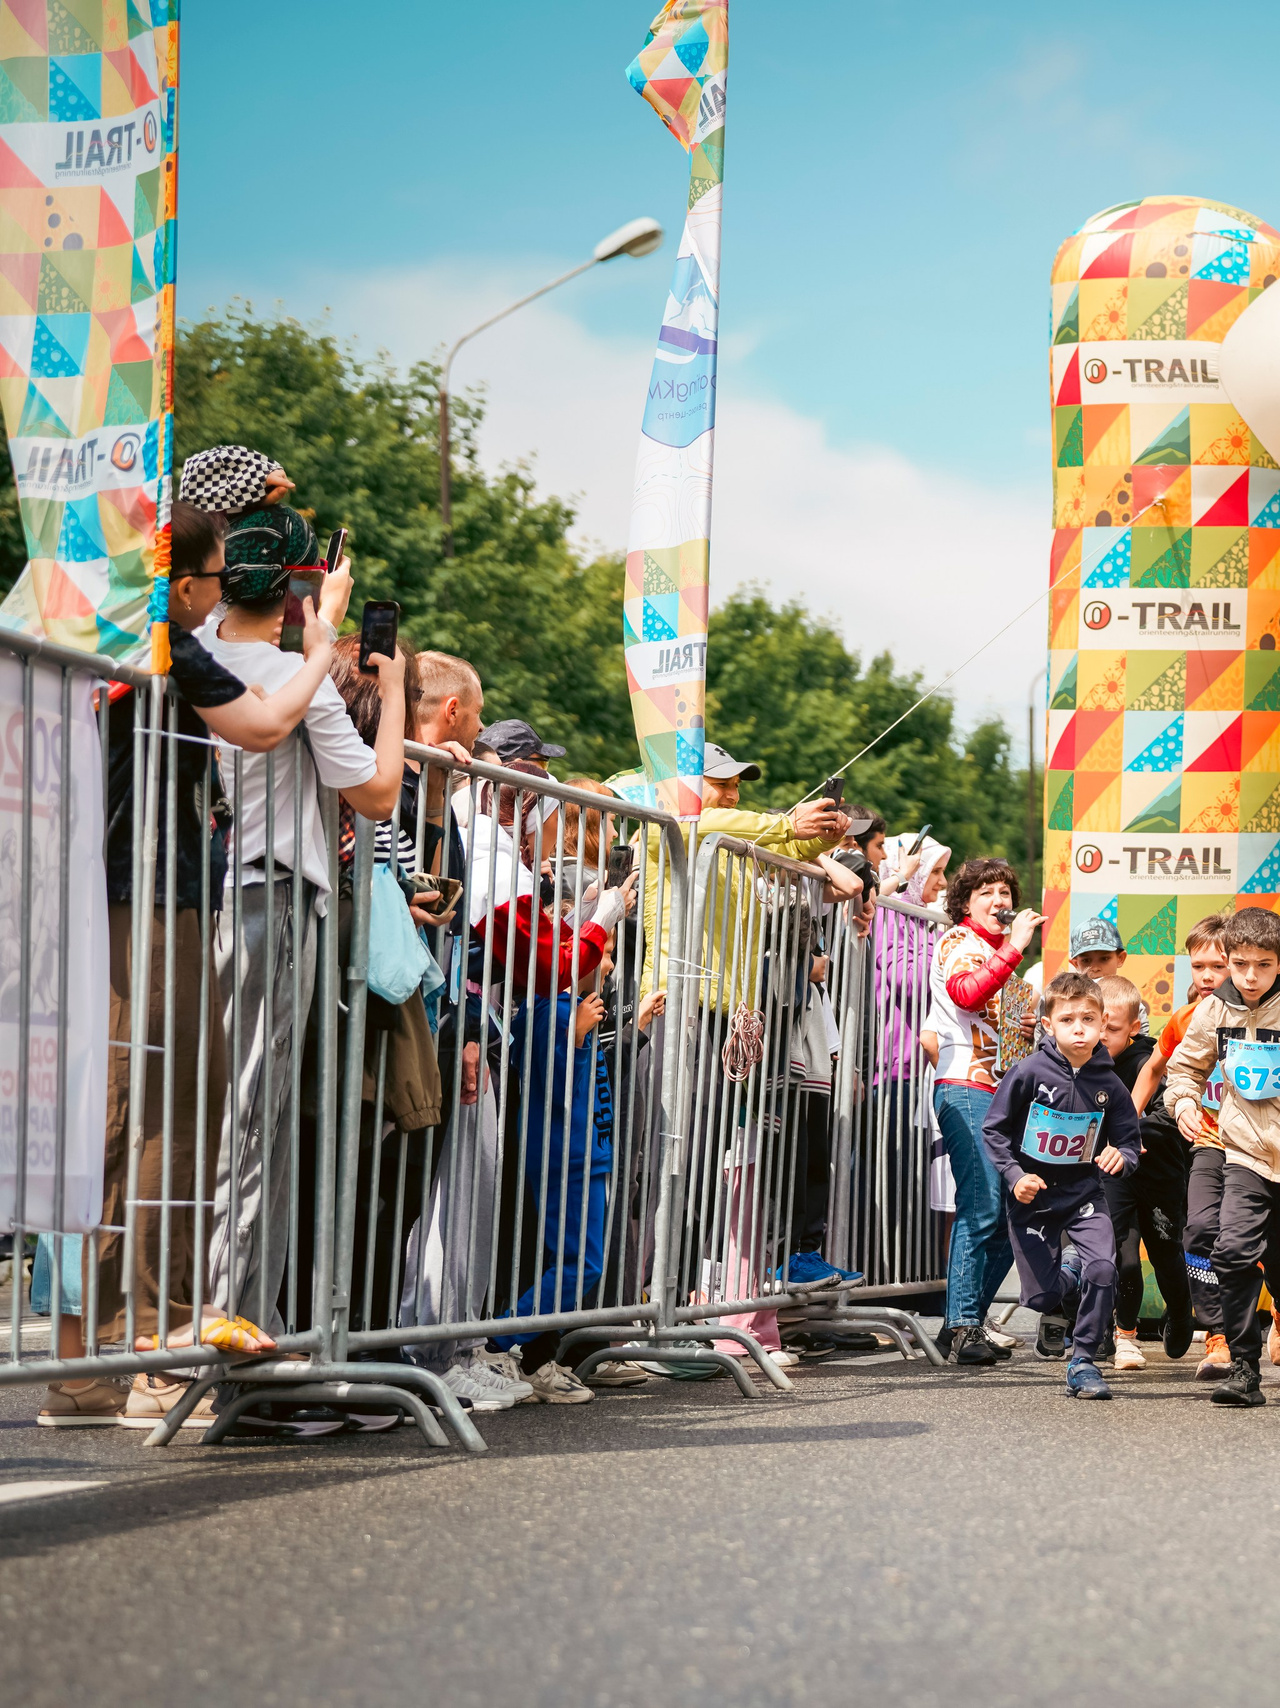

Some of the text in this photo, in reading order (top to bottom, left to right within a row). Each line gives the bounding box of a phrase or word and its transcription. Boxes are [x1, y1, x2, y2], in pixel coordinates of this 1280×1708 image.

[1084, 358, 1219, 384] O-TRAIL
[1083, 600, 1241, 631] O-TRAIL
[1075, 844, 1232, 875] O-TRAIL
[1036, 1131, 1087, 1157] 102
